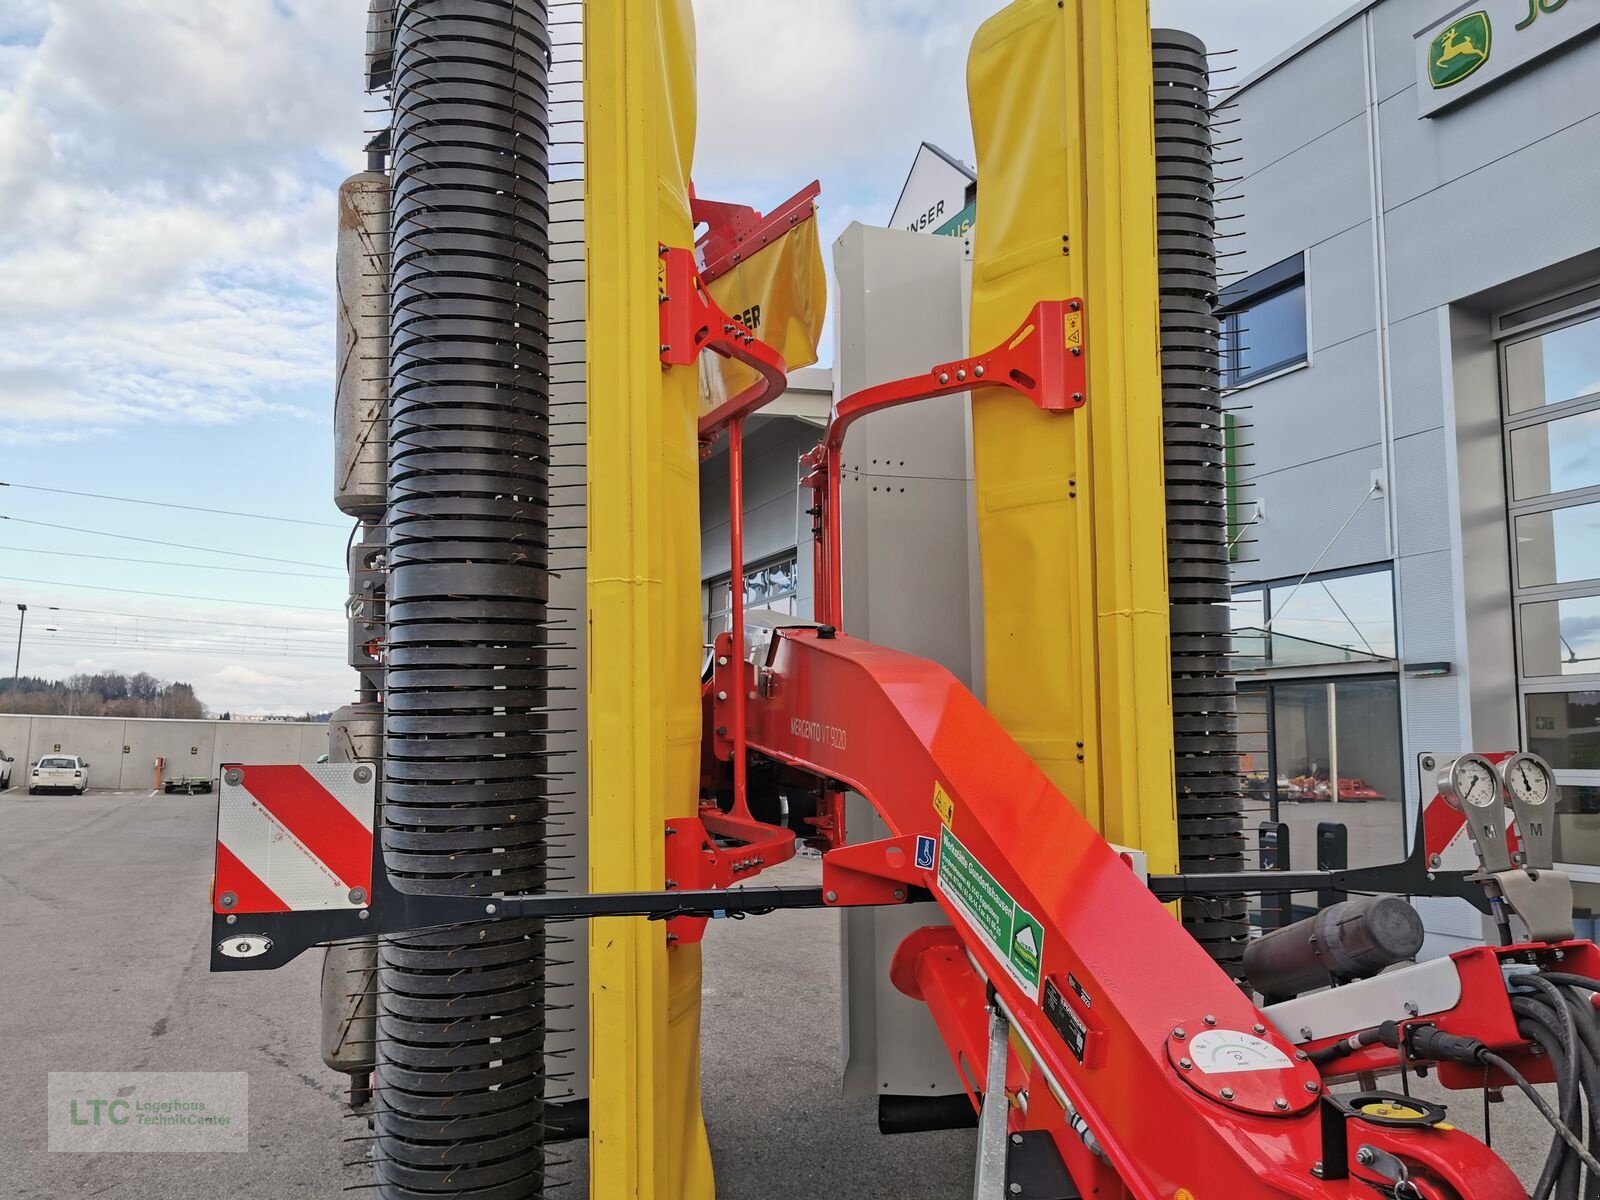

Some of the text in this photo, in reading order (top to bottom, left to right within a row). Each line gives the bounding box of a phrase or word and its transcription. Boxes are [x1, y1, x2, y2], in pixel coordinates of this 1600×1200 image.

[907, 200, 944, 232] NSER
[945, 219, 970, 240] US
[791, 717, 846, 750] MERGENTO VT 9220
[1483, 823, 1497, 838] M
[1530, 822, 1543, 837] M
[943, 833, 968, 869] Werkstätte
[968, 862, 1013, 919] Gundertshausen
